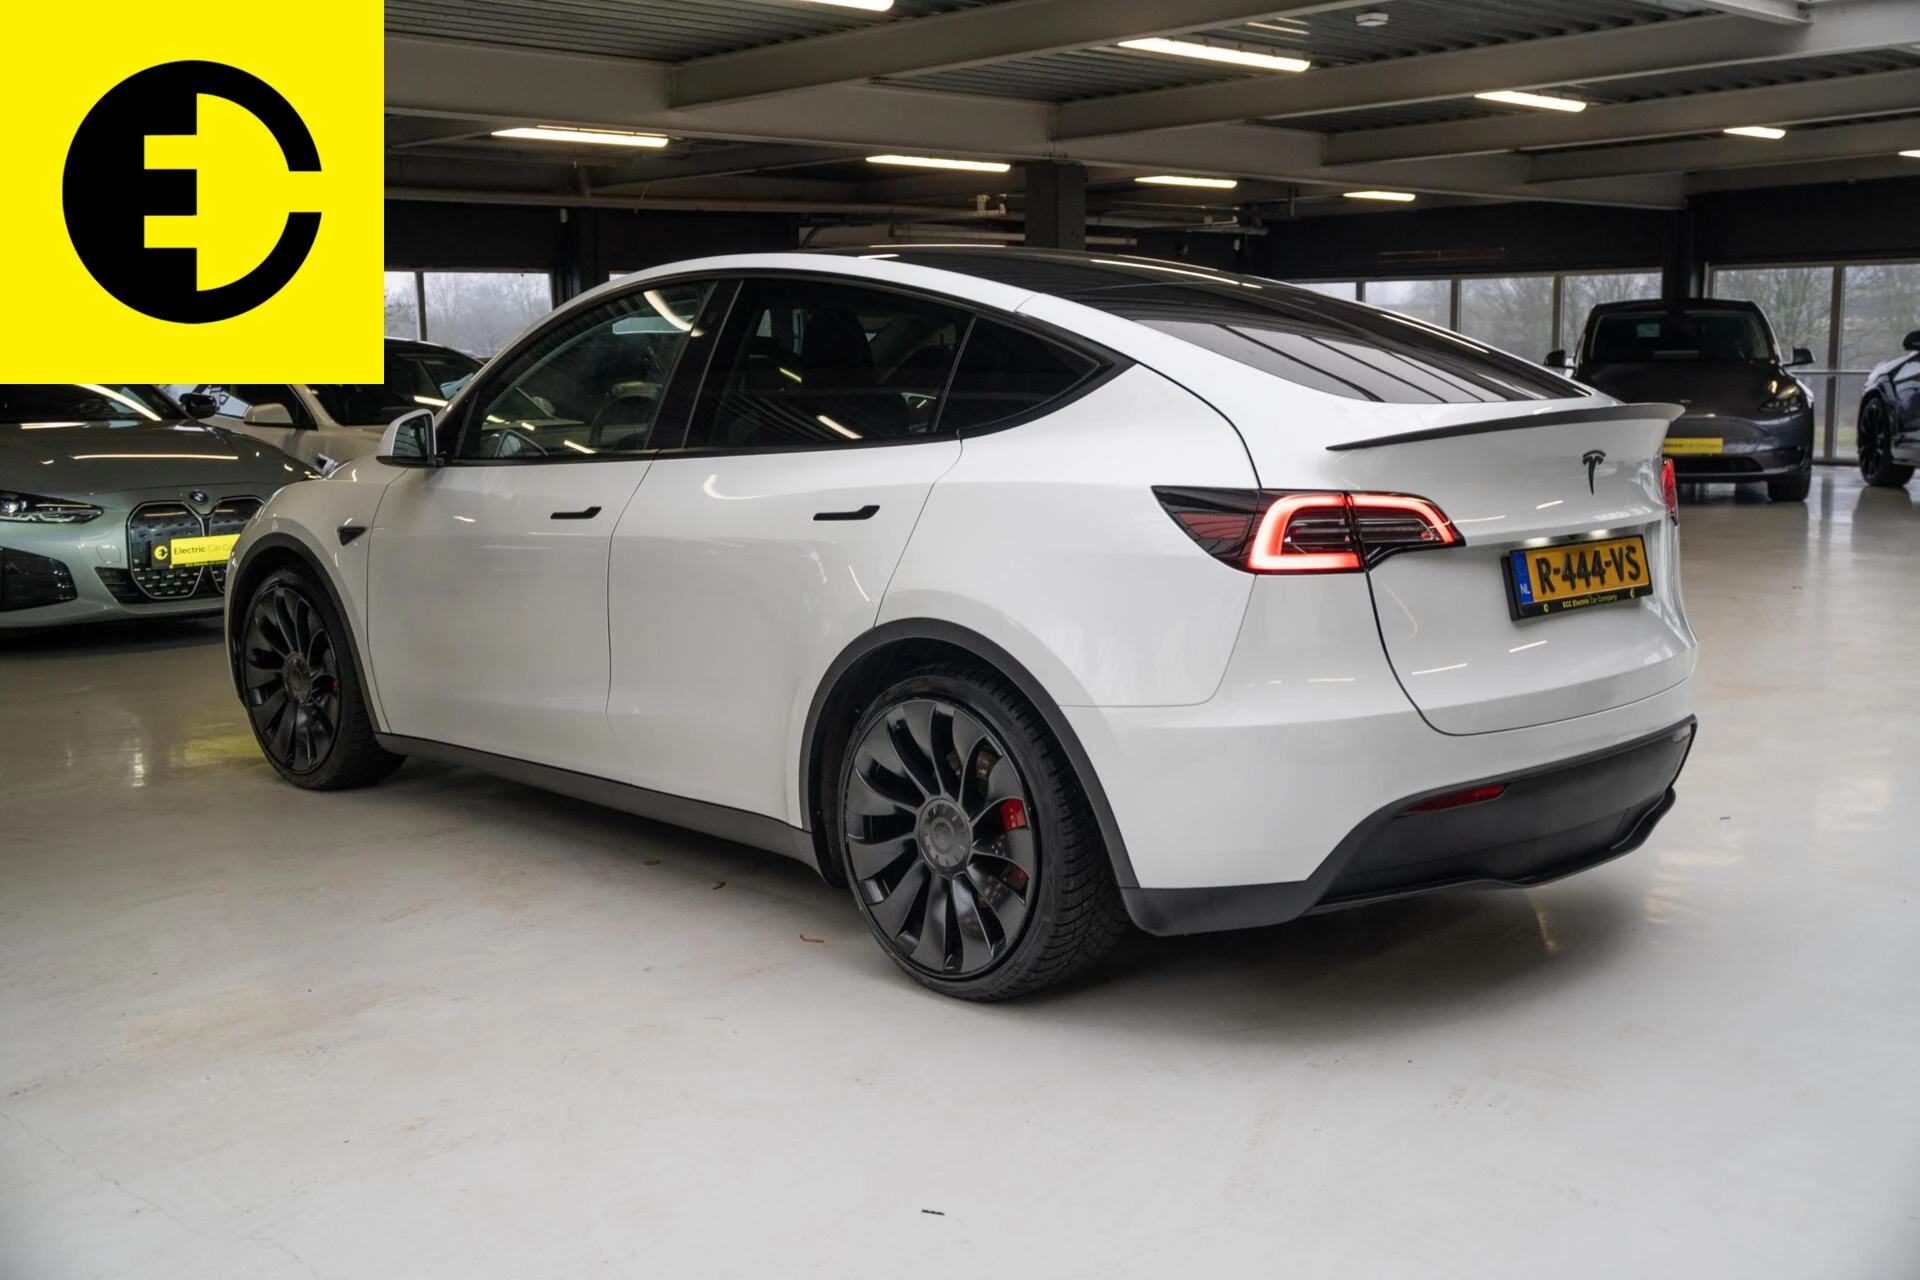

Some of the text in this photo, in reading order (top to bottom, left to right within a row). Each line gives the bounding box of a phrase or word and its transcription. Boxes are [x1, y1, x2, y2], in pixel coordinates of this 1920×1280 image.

[174, 545, 206, 555] Electric
[207, 544, 221, 552] Car
[1535, 545, 1641, 595] R-444-VS
[1520, 583, 1531, 595] NL
[1562, 599, 1572, 609] ECC
[1572, 598, 1589, 608] Electric
[1598, 594, 1618, 603] Company
